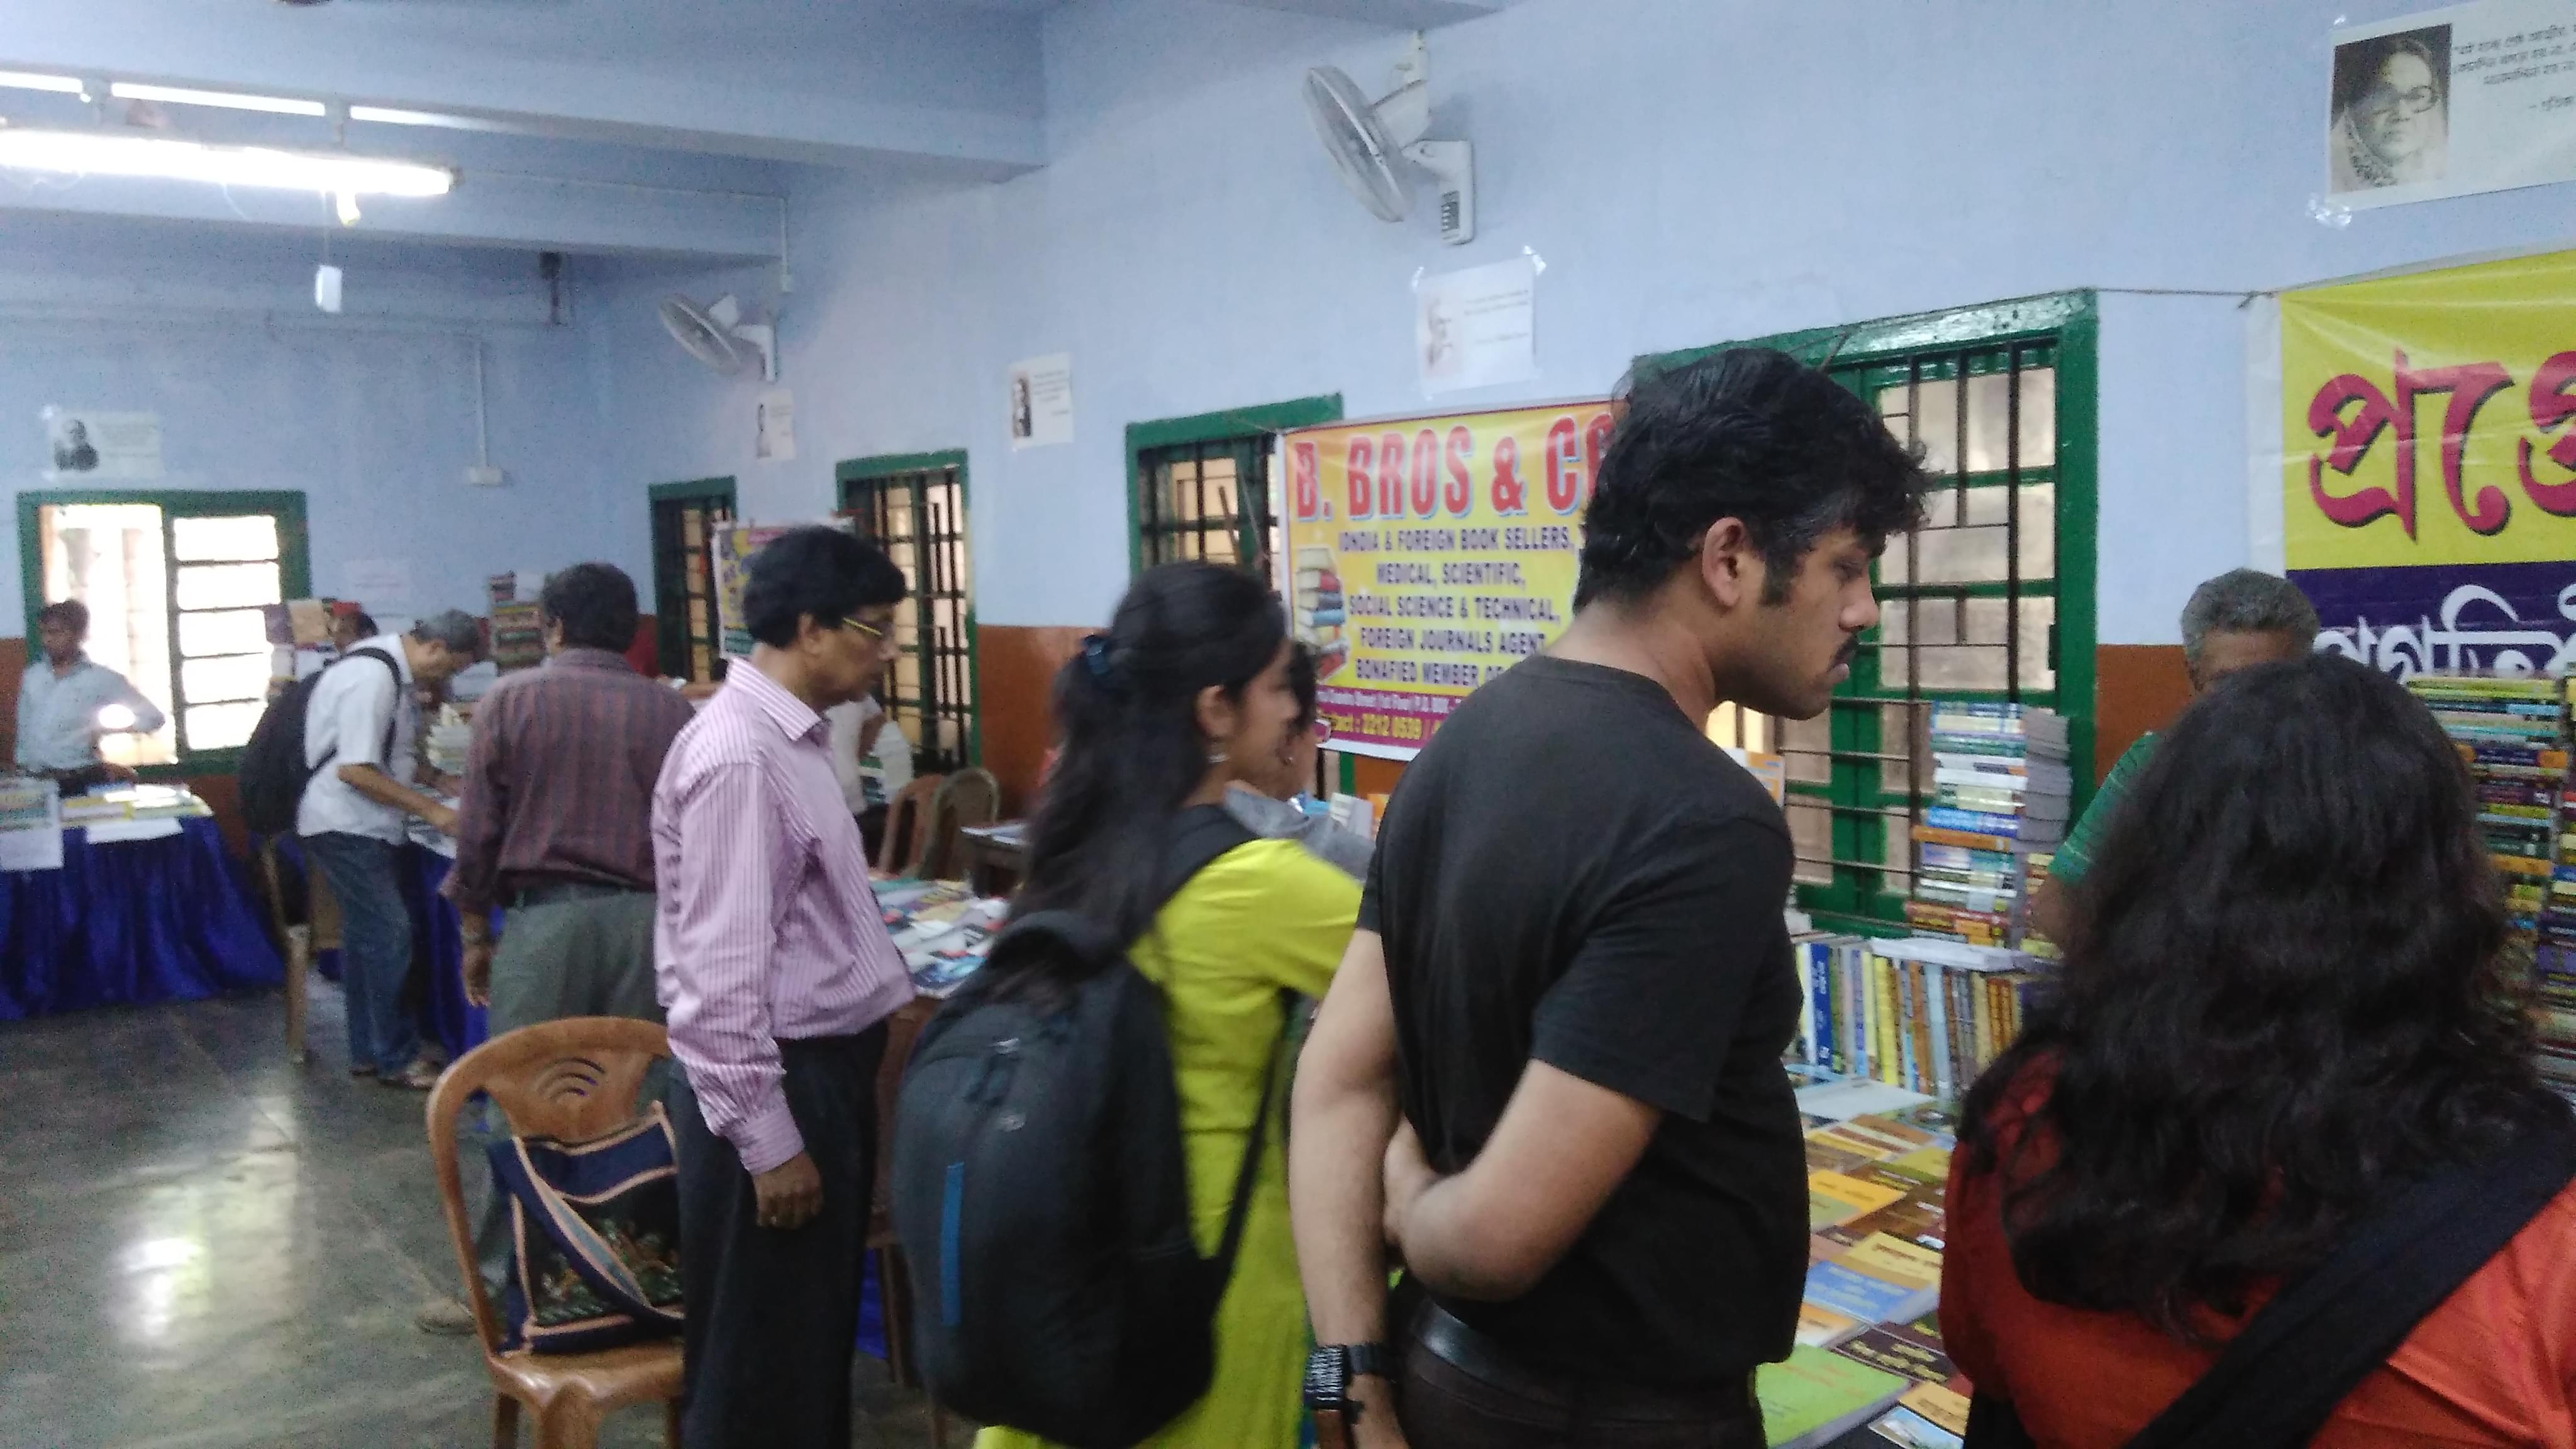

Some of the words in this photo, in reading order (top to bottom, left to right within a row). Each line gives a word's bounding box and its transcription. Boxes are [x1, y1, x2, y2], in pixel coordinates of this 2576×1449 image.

[1294, 441, 1333, 520] B.
[1347, 426, 1472, 521] BROS
[1491, 436, 1526, 516] &
[1398, 528, 1455, 551] FOREIGN
[1461, 527, 1499, 550] BOOK
[1377, 563, 1436, 588] MEDICAL,
[1349, 596, 1391, 617] SOCIAL
[1397, 596, 1453, 619] SCIENCE
[1360, 627, 1414, 650] FOREIGN
[1421, 628, 1492, 654] JOURNALS
